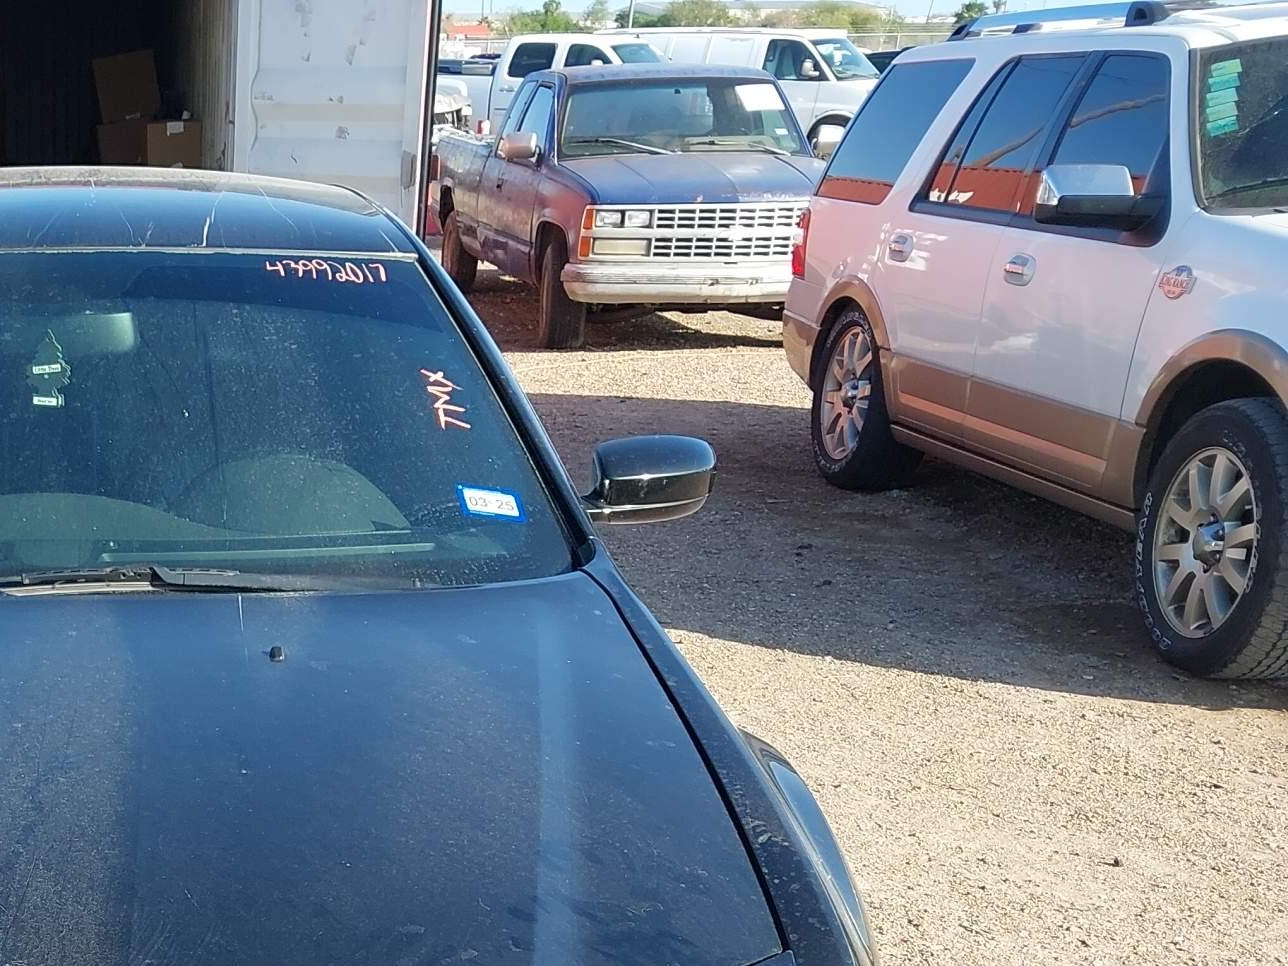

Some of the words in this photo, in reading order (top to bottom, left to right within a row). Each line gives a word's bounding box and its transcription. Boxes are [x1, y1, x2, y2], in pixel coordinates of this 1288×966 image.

[265, 259, 387, 283] 43992017
[469, 496, 488, 507] 03
[496, 499, 515, 511] 25
